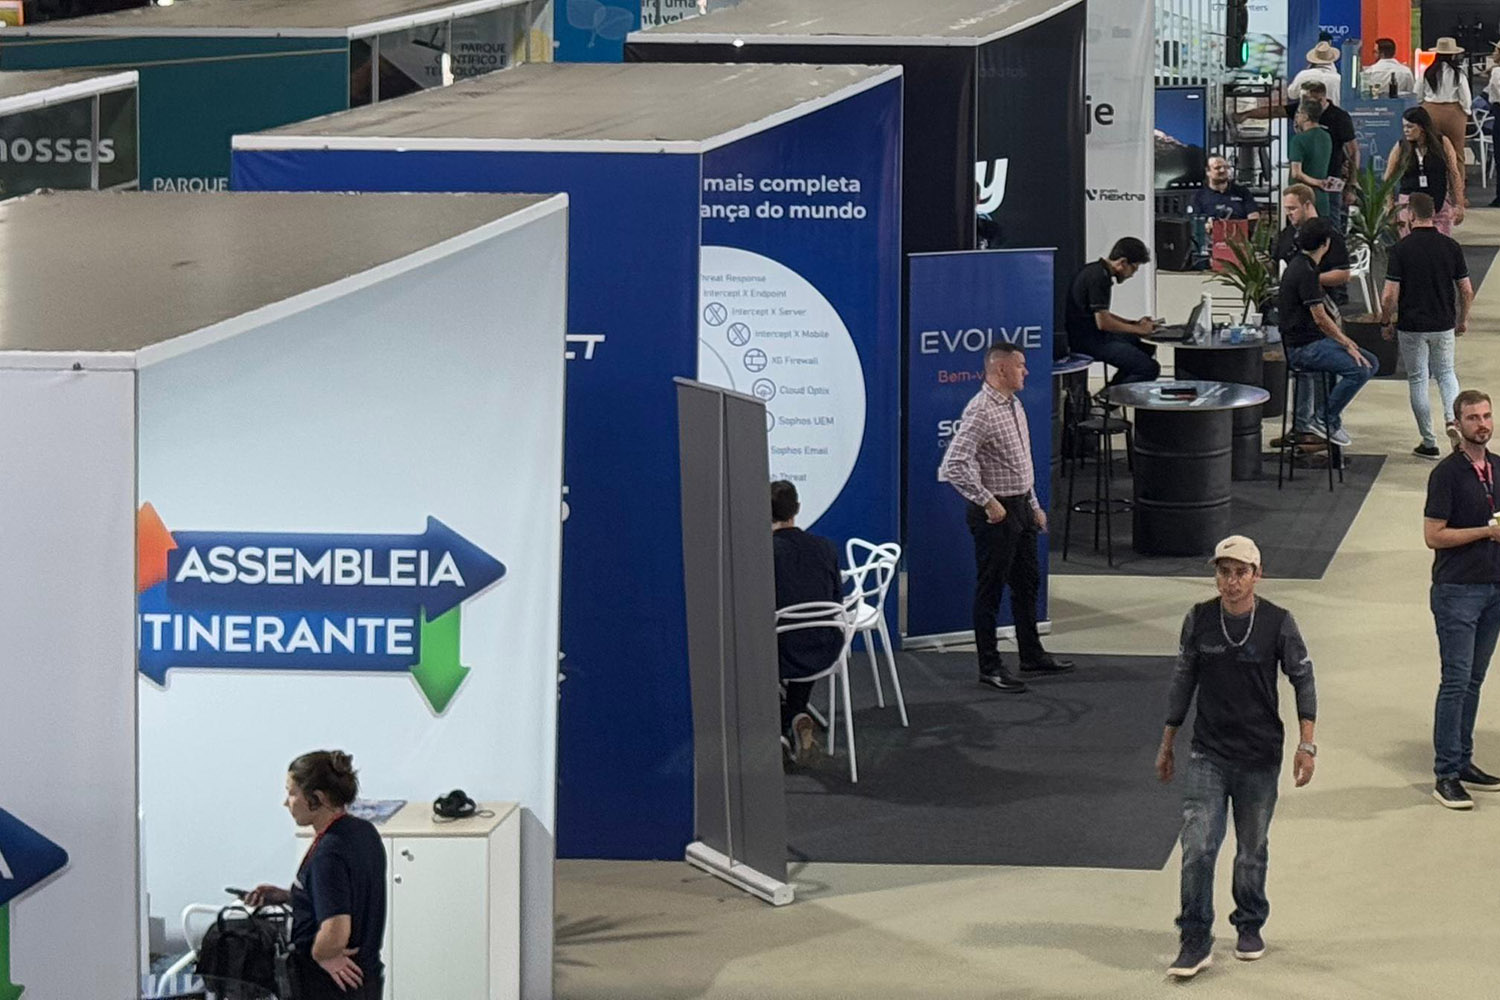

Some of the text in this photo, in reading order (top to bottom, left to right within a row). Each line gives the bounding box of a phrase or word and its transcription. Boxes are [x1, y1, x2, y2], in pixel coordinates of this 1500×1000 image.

[153, 177, 229, 193] PARQUE
[703, 173, 861, 196] mais completa
[700, 200, 867, 223] ança do mundo
[751, 289, 787, 299] Endpoint
[779, 415, 812, 427] Sophos
[175, 545, 466, 588] ASSEMBLEIA
[138, 613, 415, 655] TINERANTE
